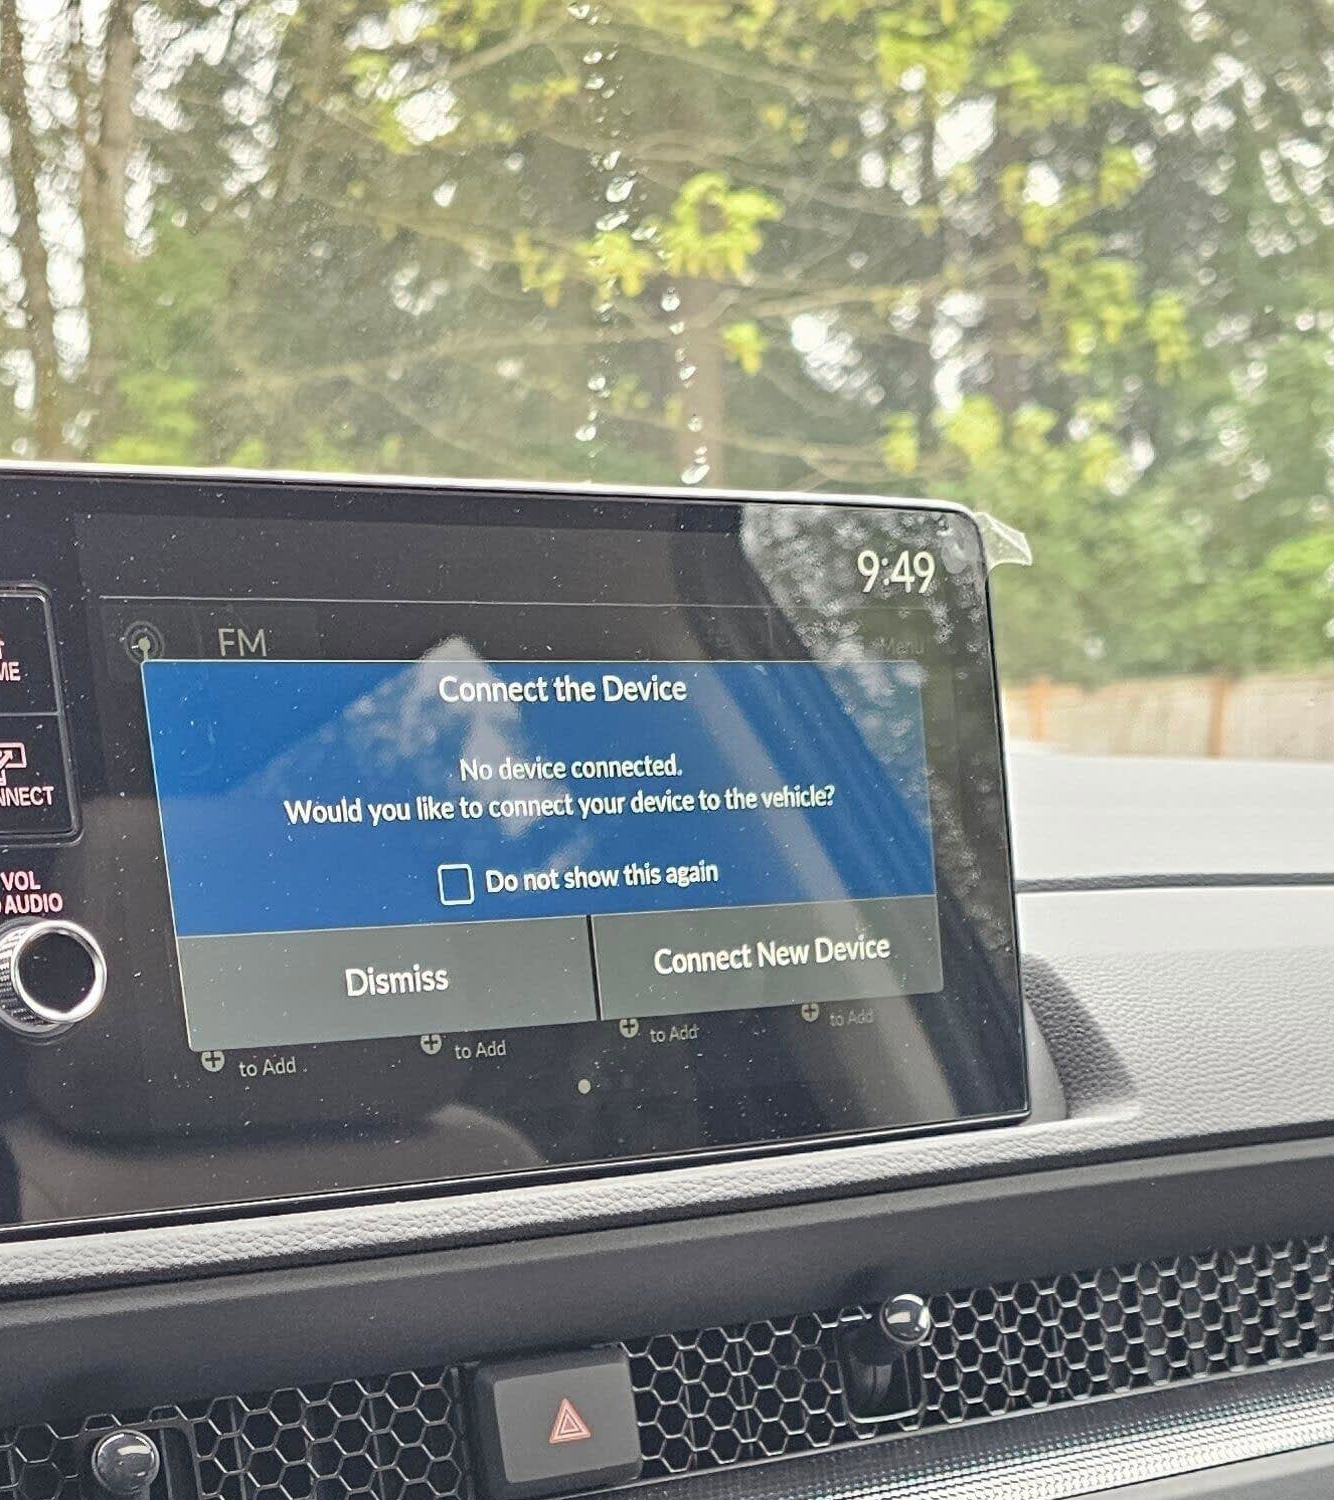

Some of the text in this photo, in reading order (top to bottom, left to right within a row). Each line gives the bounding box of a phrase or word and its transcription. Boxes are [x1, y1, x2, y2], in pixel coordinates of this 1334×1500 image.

[857, 550, 936, 594] 9:49
[218, 628, 267, 657] FM
[438, 674, 687, 703] Connect the Device
[459, 753, 683, 781] No device connected.
[283, 784, 836, 827] Would you like to connect your device to the vehicle?
[0, 870, 41, 891] VOL
[485, 859, 719, 893] Do not show this again
[4, 892, 64, 914] AUDIO
[654, 934, 891, 976] Connect New Device
[345, 964, 450, 998] Dismiss
[650, 1023, 702, 1043] to Add
[454, 1039, 507, 1060] to Add
[239, 1056, 297, 1078] to Add
